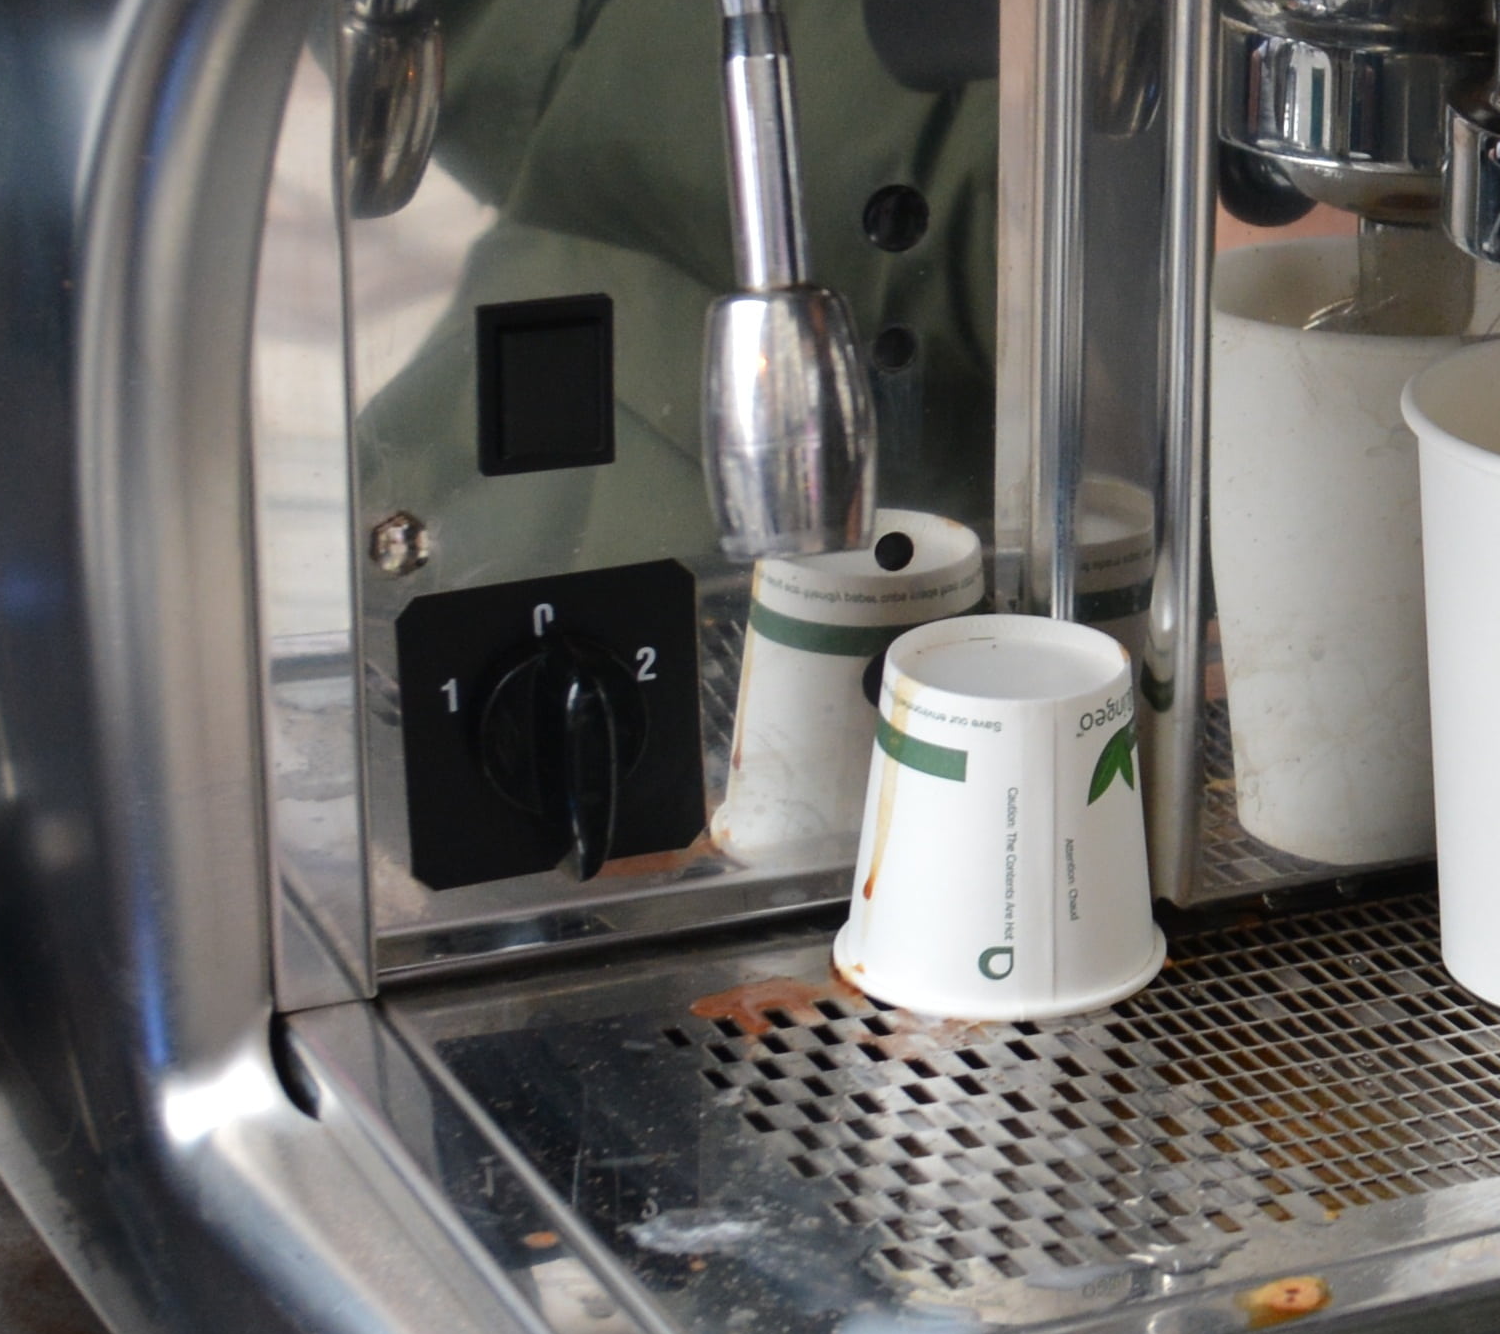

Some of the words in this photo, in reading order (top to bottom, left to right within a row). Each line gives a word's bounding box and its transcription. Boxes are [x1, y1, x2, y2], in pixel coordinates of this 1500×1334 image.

[635, 646, 657, 682] 2
[440, 677, 459, 713] 1
[1006, 832, 1018, 852] The
[1005, 854, 1017, 899] Contents
[1004, 901, 1016, 919] Are
[1004, 921, 1015, 941] Hot
